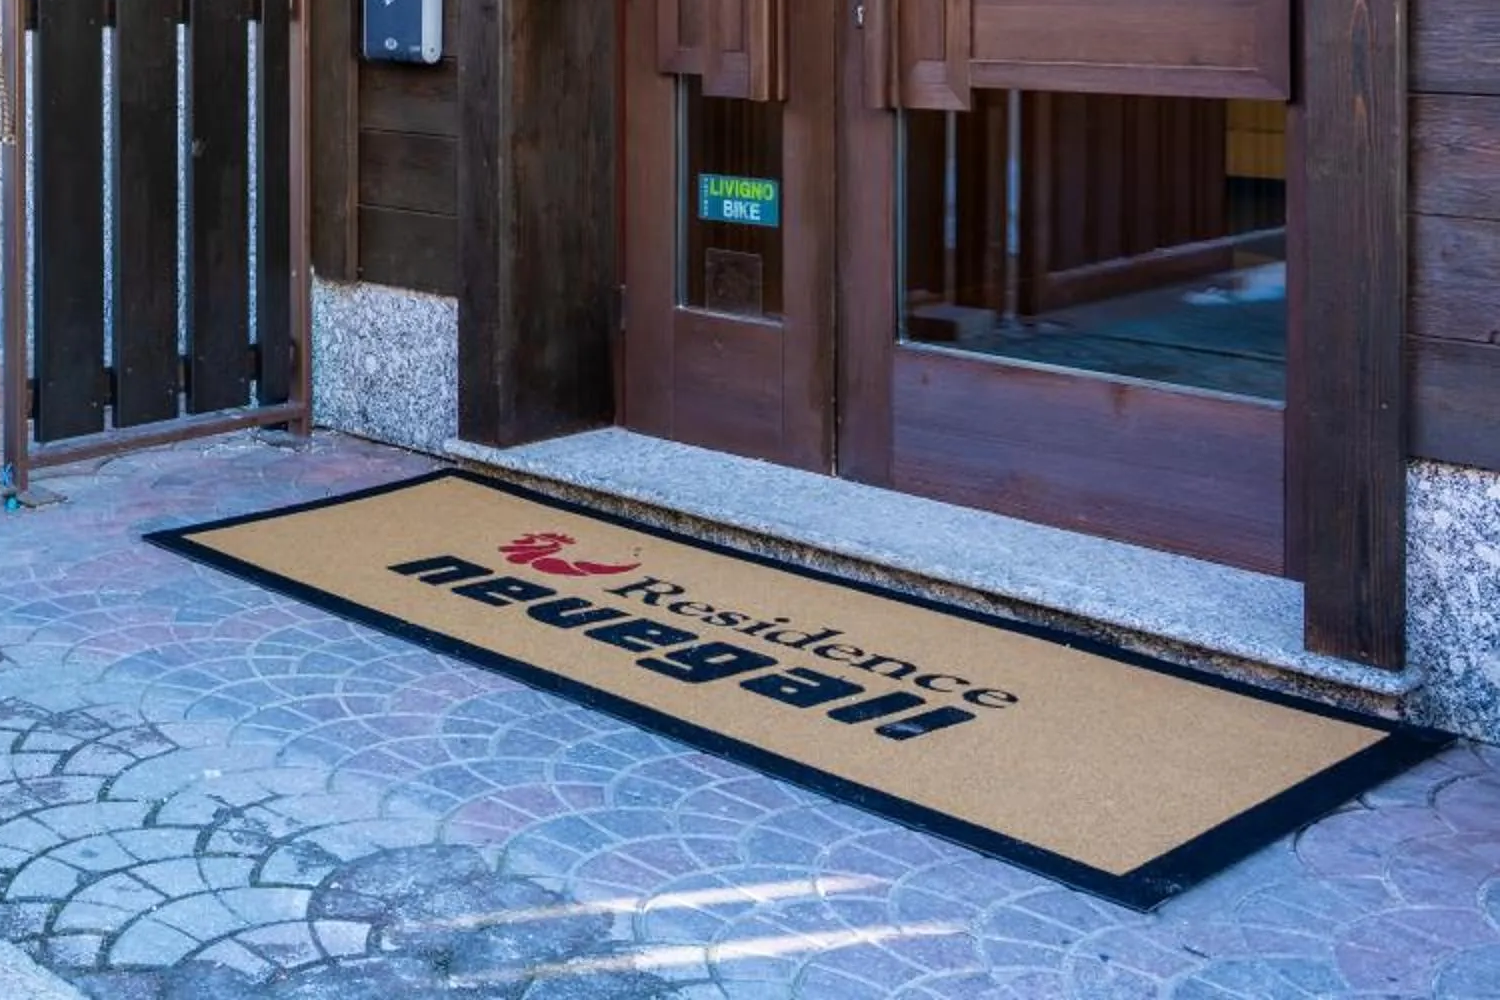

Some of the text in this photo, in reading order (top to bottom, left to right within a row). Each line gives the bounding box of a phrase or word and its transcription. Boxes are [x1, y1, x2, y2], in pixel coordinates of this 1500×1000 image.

[709, 177, 774, 201] LIVIGNO
[723, 199, 761, 220] BIKE
[388, 554, 977, 741] neuegall
[603, 576, 1019, 711] Residence
